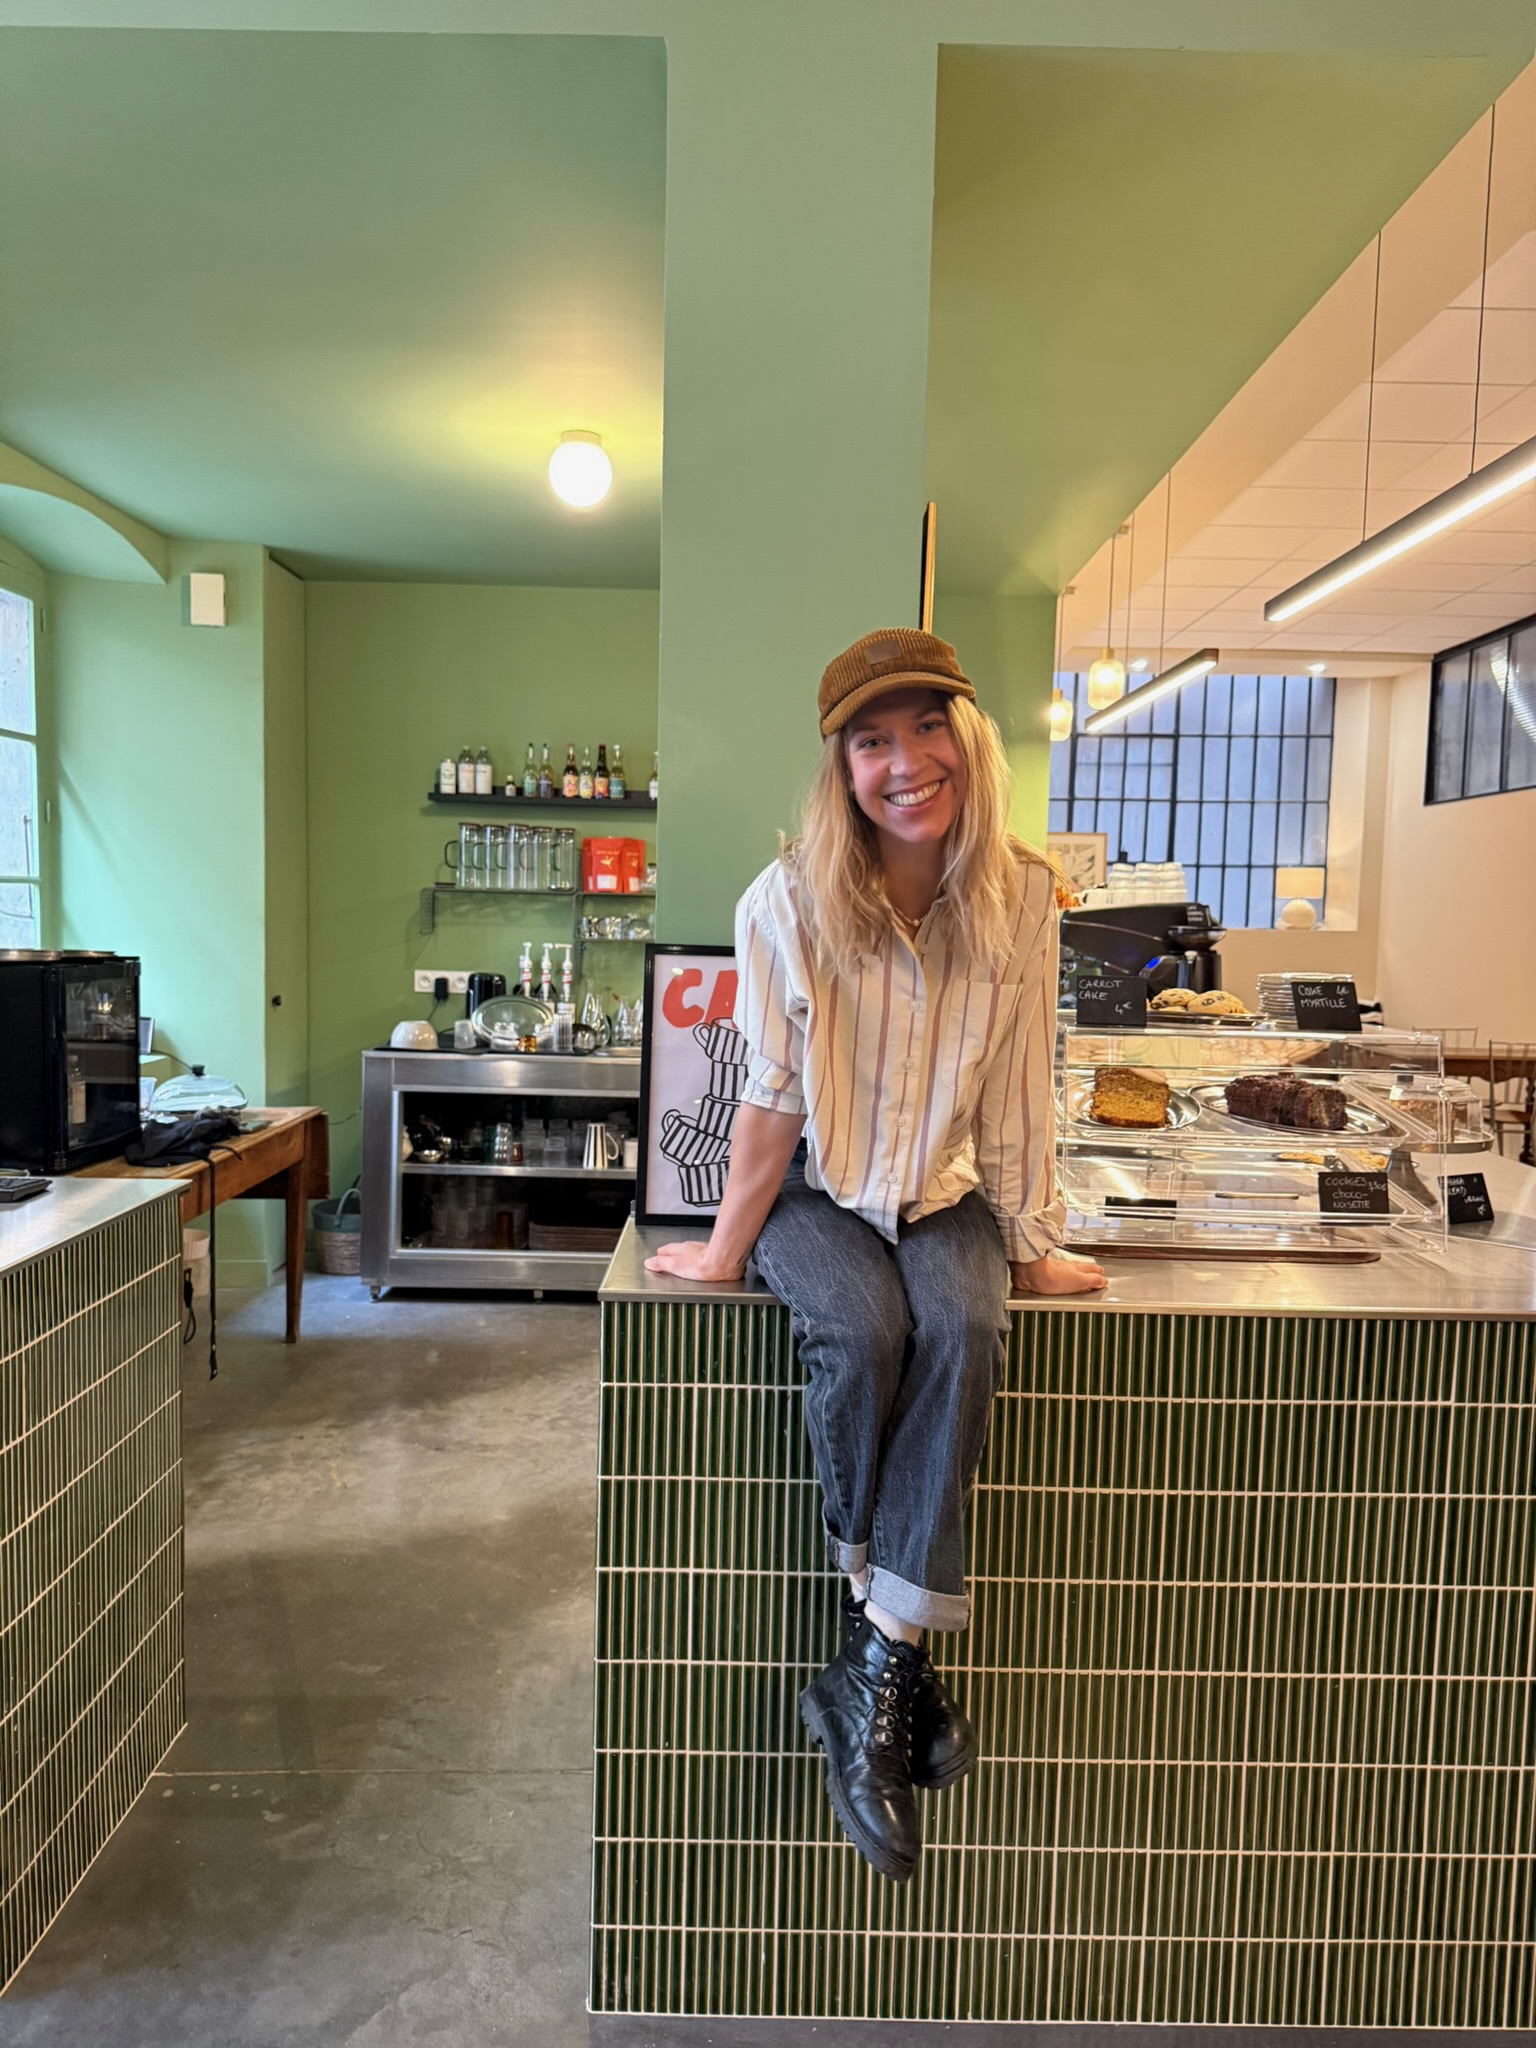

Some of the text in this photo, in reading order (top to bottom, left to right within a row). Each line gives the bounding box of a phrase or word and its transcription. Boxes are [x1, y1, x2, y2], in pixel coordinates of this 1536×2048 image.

[1078, 979, 1123, 989] CARROT
[1078, 990, 1108, 1001] CAKE
[1115, 1001, 1133, 1015] 4€
[1300, 997, 1347, 1008] MYRTILLE
[1333, 1200, 1371, 1209] NOISETTE
